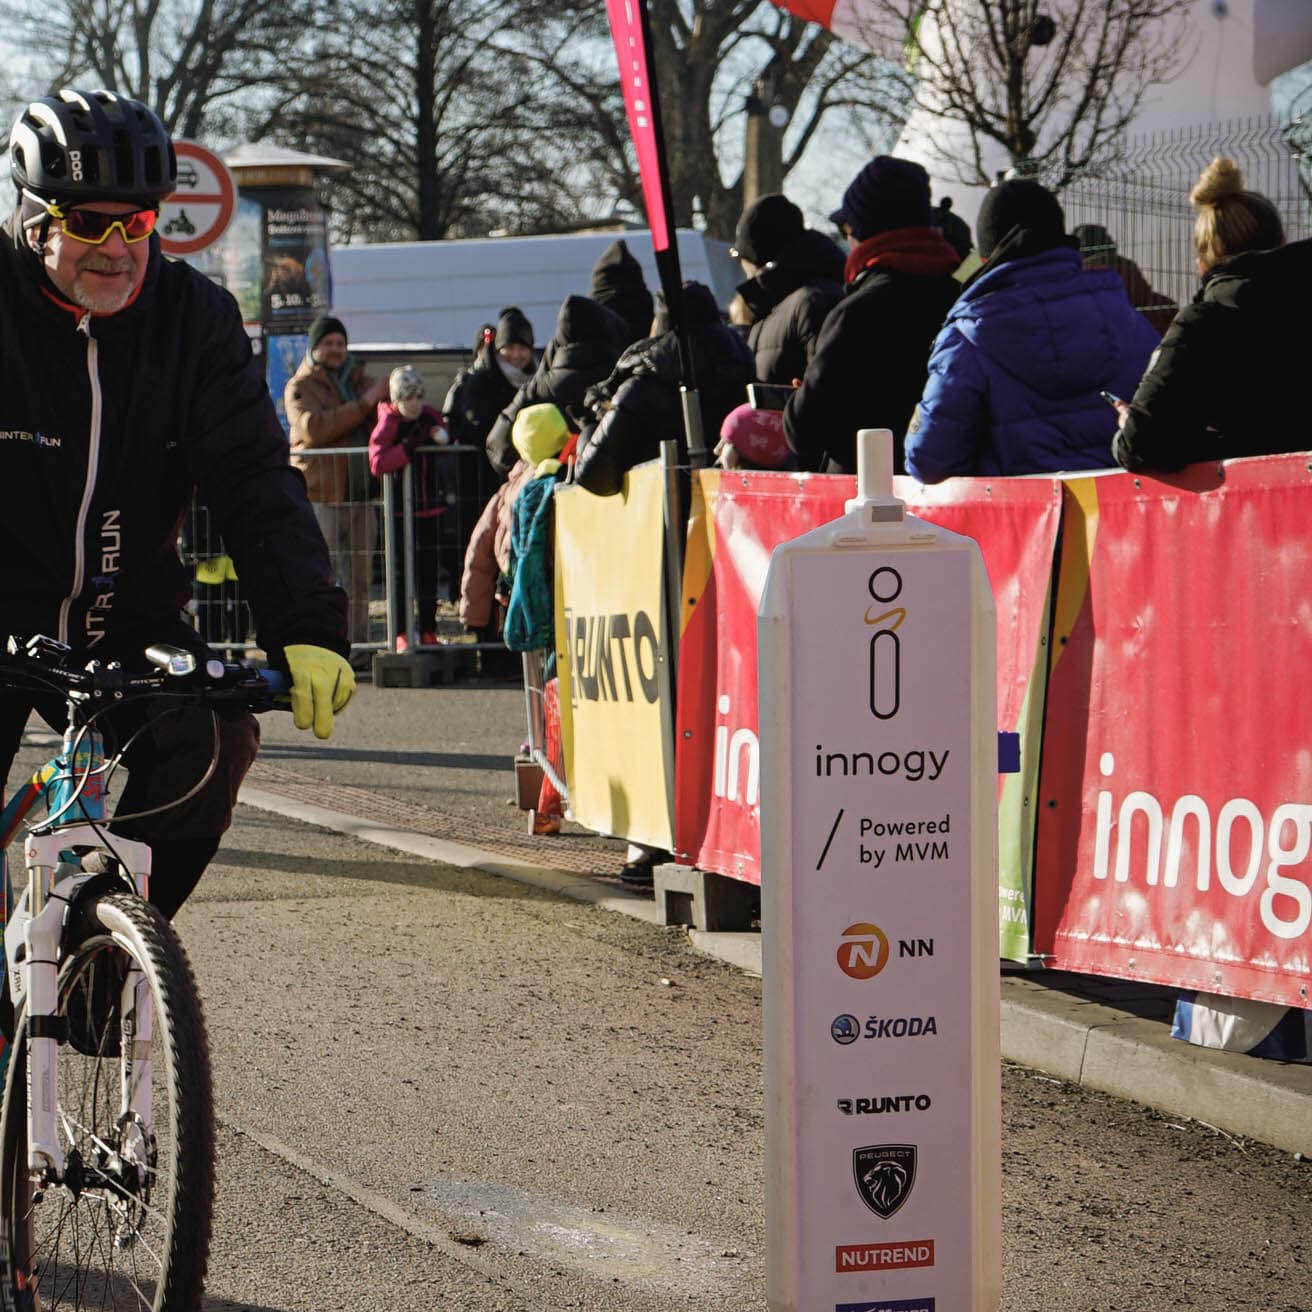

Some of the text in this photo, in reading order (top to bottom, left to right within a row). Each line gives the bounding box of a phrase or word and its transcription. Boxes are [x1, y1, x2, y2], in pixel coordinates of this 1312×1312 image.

[100, 509, 121, 573] RUN
[816, 744, 950, 782] innogy
[860, 814, 950, 837] Powered
[860, 841, 949, 868] by MVM
[1094, 751, 1312, 939] innog
[898, 938, 934, 958] NN
[864, 1015, 937, 1039] ŠKODA
[855, 1094, 932, 1115] RUNTO
[859, 1150, 912, 1160] PEUGEOT
[841, 1246, 930, 1266] NUTREND
